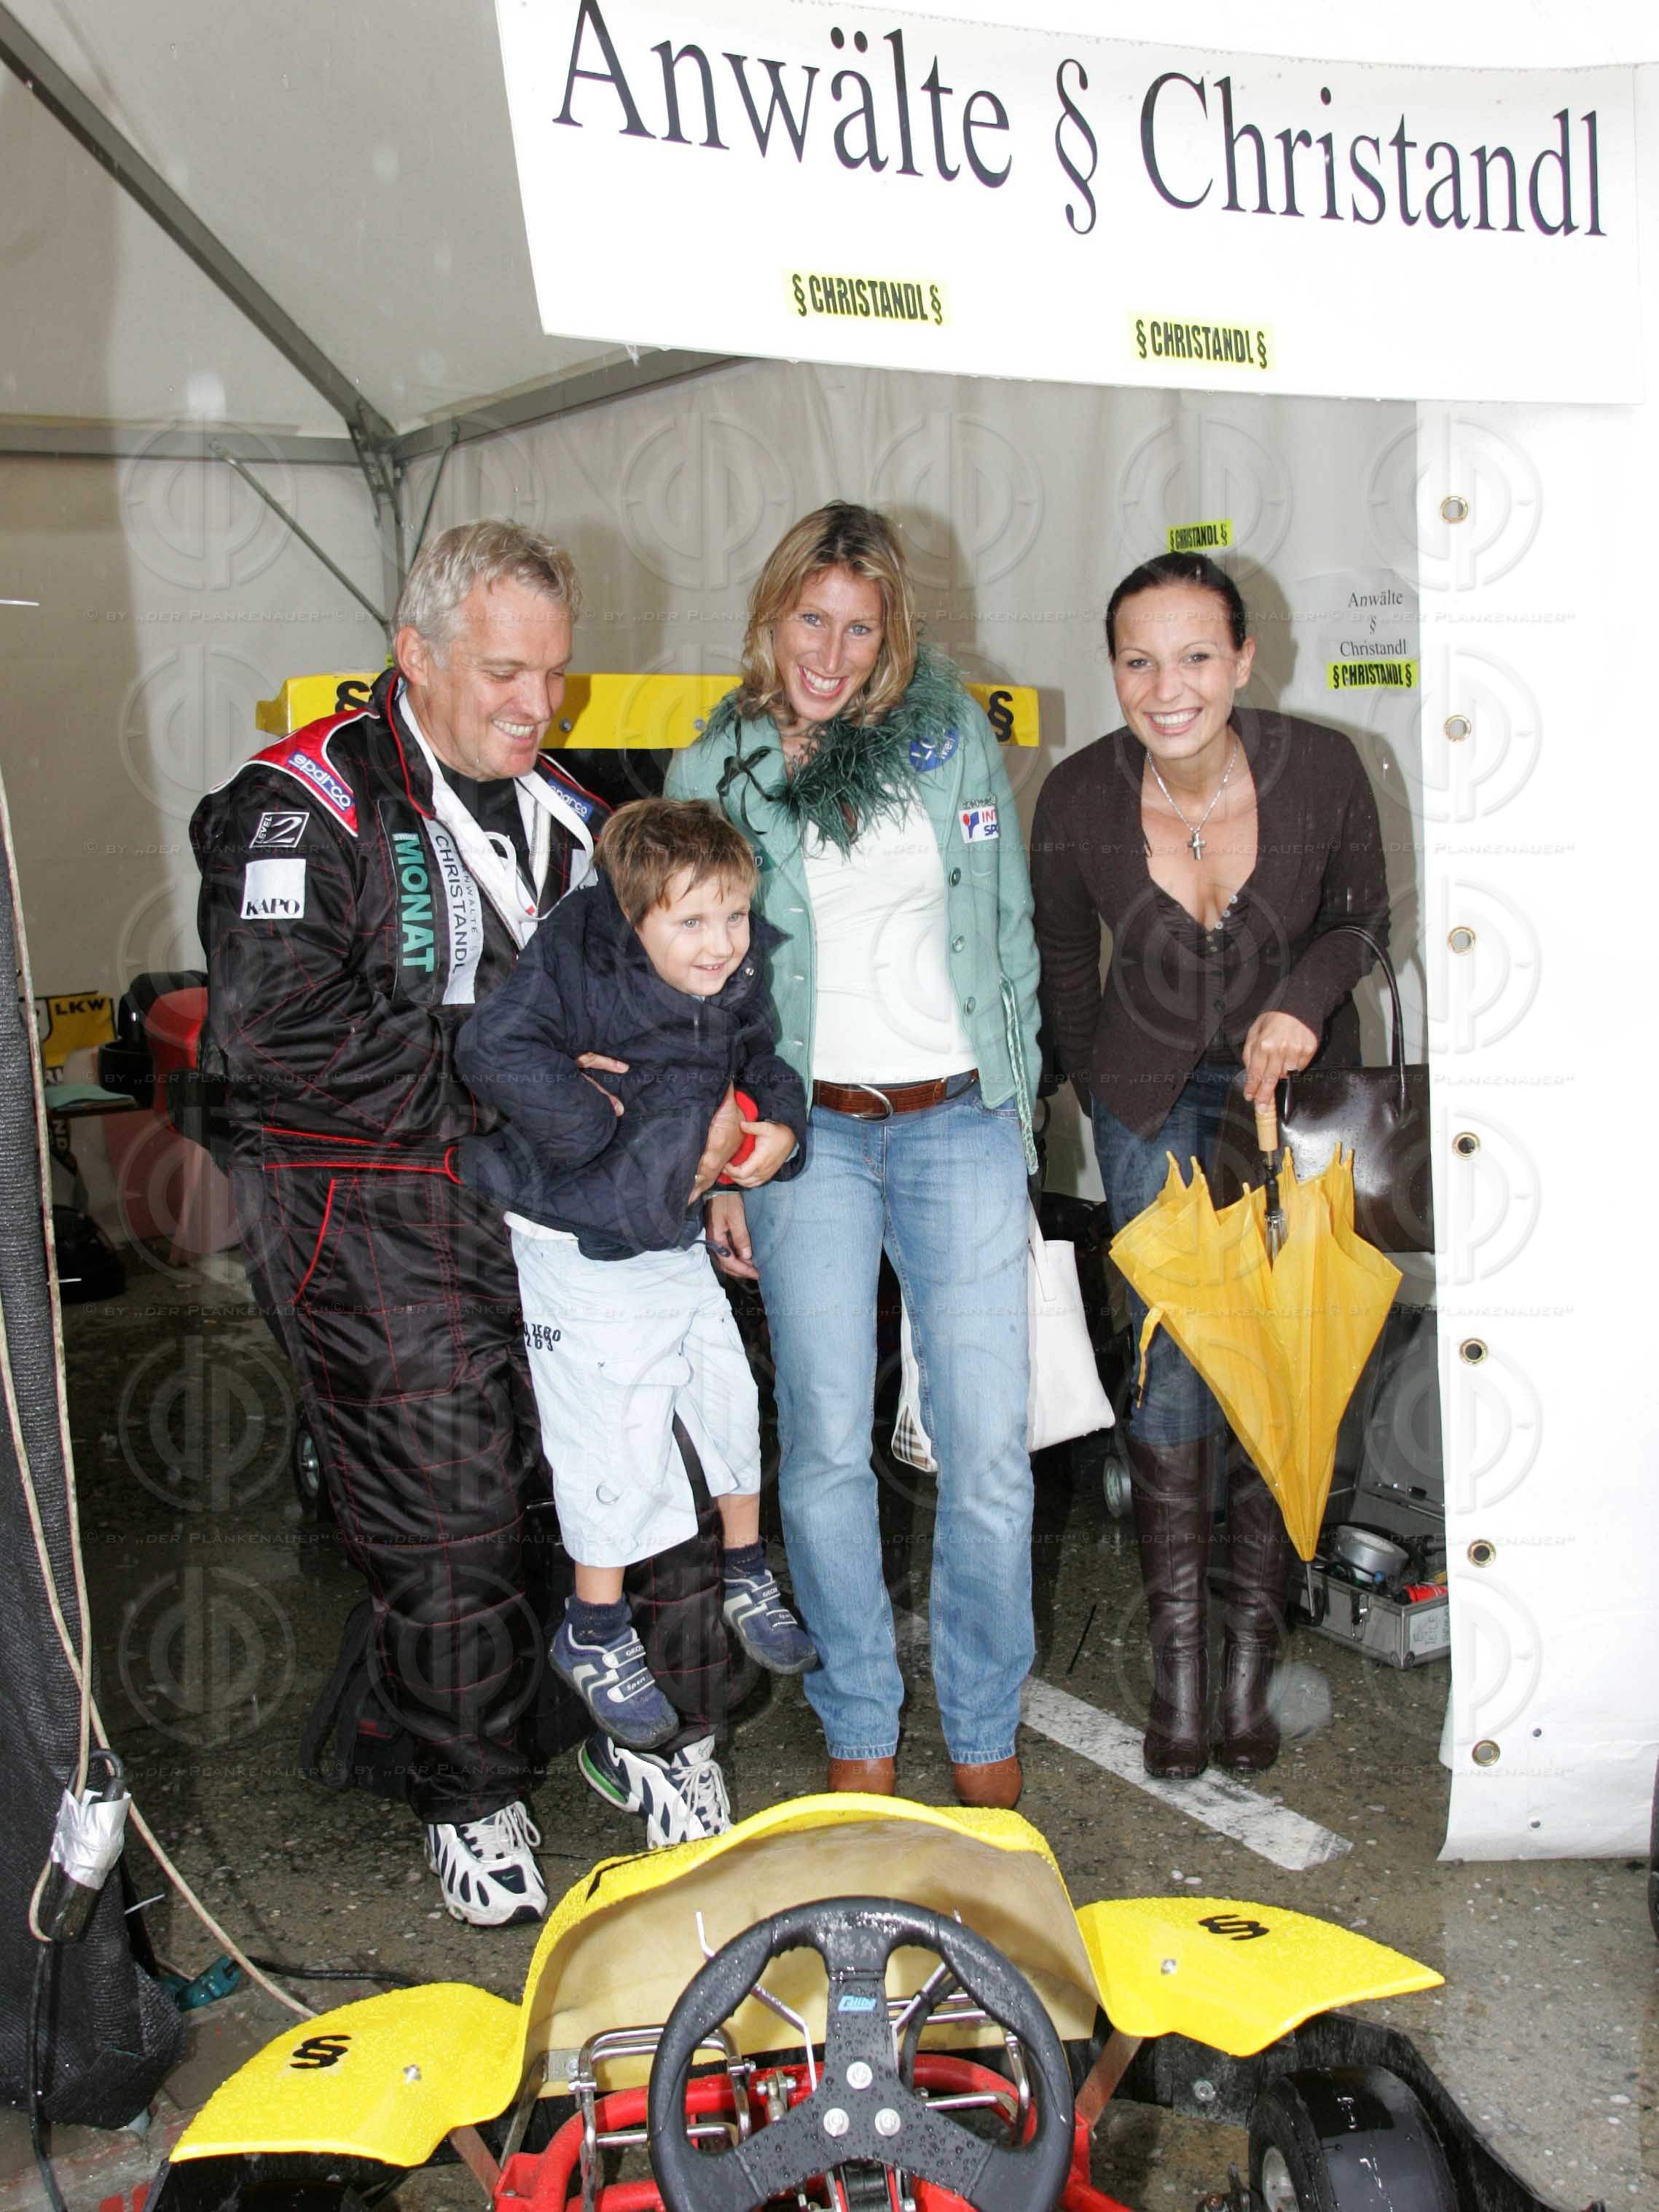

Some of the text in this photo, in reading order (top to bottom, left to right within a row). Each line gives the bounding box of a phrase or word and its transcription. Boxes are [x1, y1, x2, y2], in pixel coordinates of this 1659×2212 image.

[552, 0, 1607, 238] Anwälte § Christandl
[792, 273, 943, 325] § CHRISTANDL §
[1136, 319, 1267, 369] § CHRISTANDL §
[1340, 638, 1407, 656] Christandl
[1341, 663, 1403, 686] CHRISTANDL
[293, 753, 352, 808] sparco
[246, 897, 300, 916] KAPO
[393, 833, 434, 973] MONAT
[436, 835, 468, 974] CHRISTANDL
[55, 998, 106, 1015] LKW
